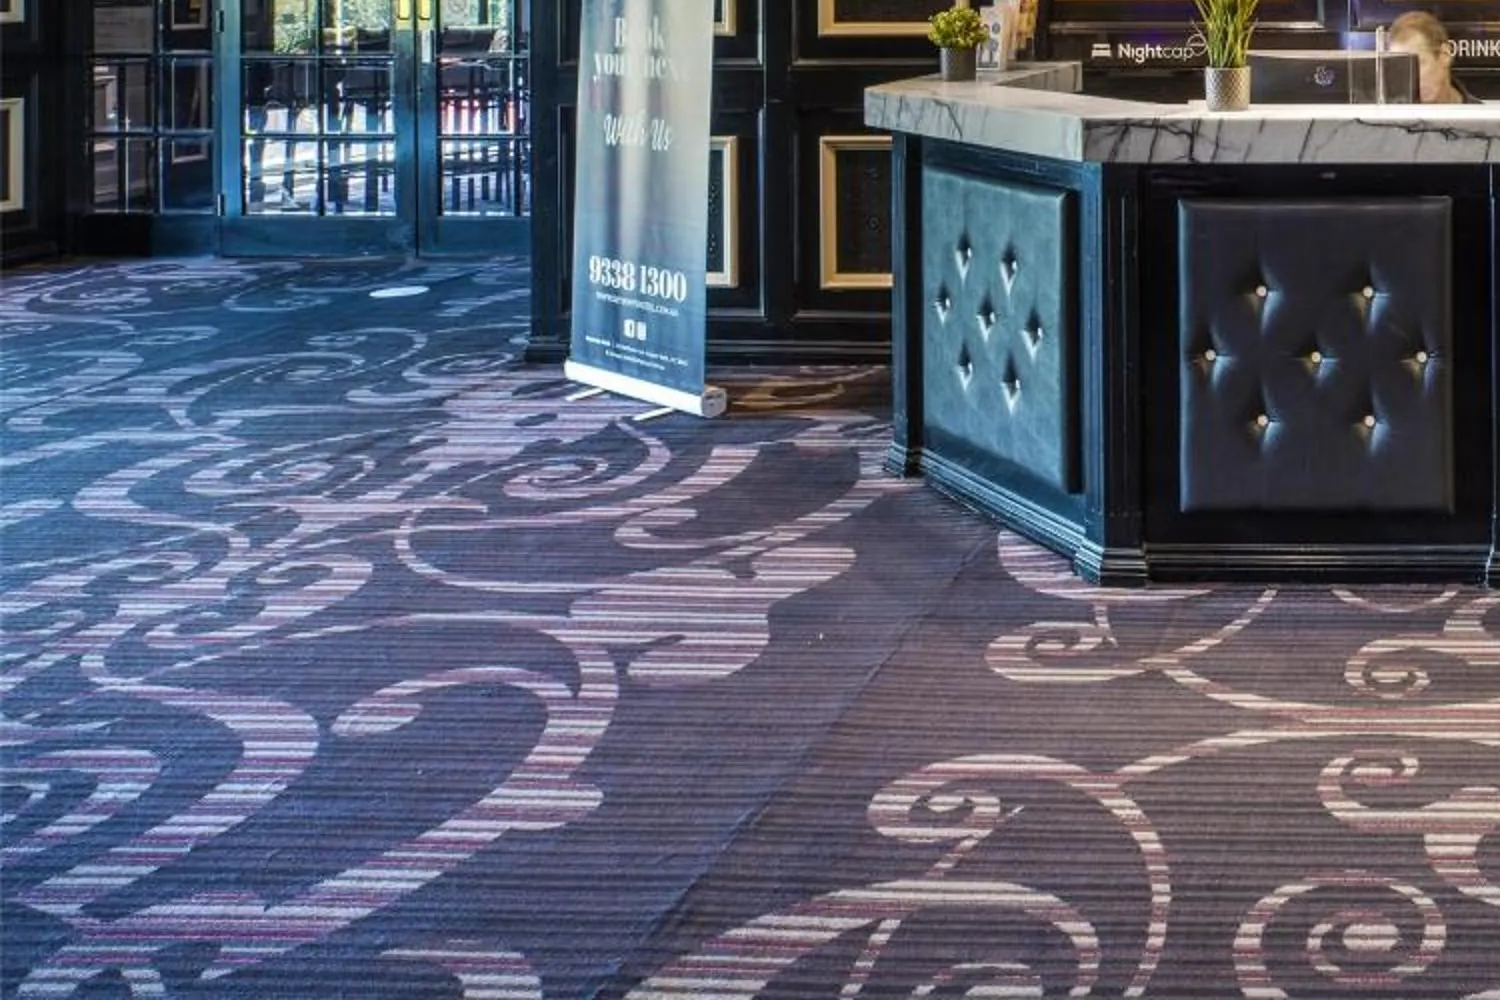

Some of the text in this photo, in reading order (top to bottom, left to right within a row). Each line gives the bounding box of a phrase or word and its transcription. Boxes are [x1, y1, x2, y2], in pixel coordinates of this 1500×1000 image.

[613, 15, 665, 50] Bok
[1117, 43, 1195, 63] Nightcap
[651, 117, 674, 152] Us
[589, 254, 688, 304] 9338 1300
